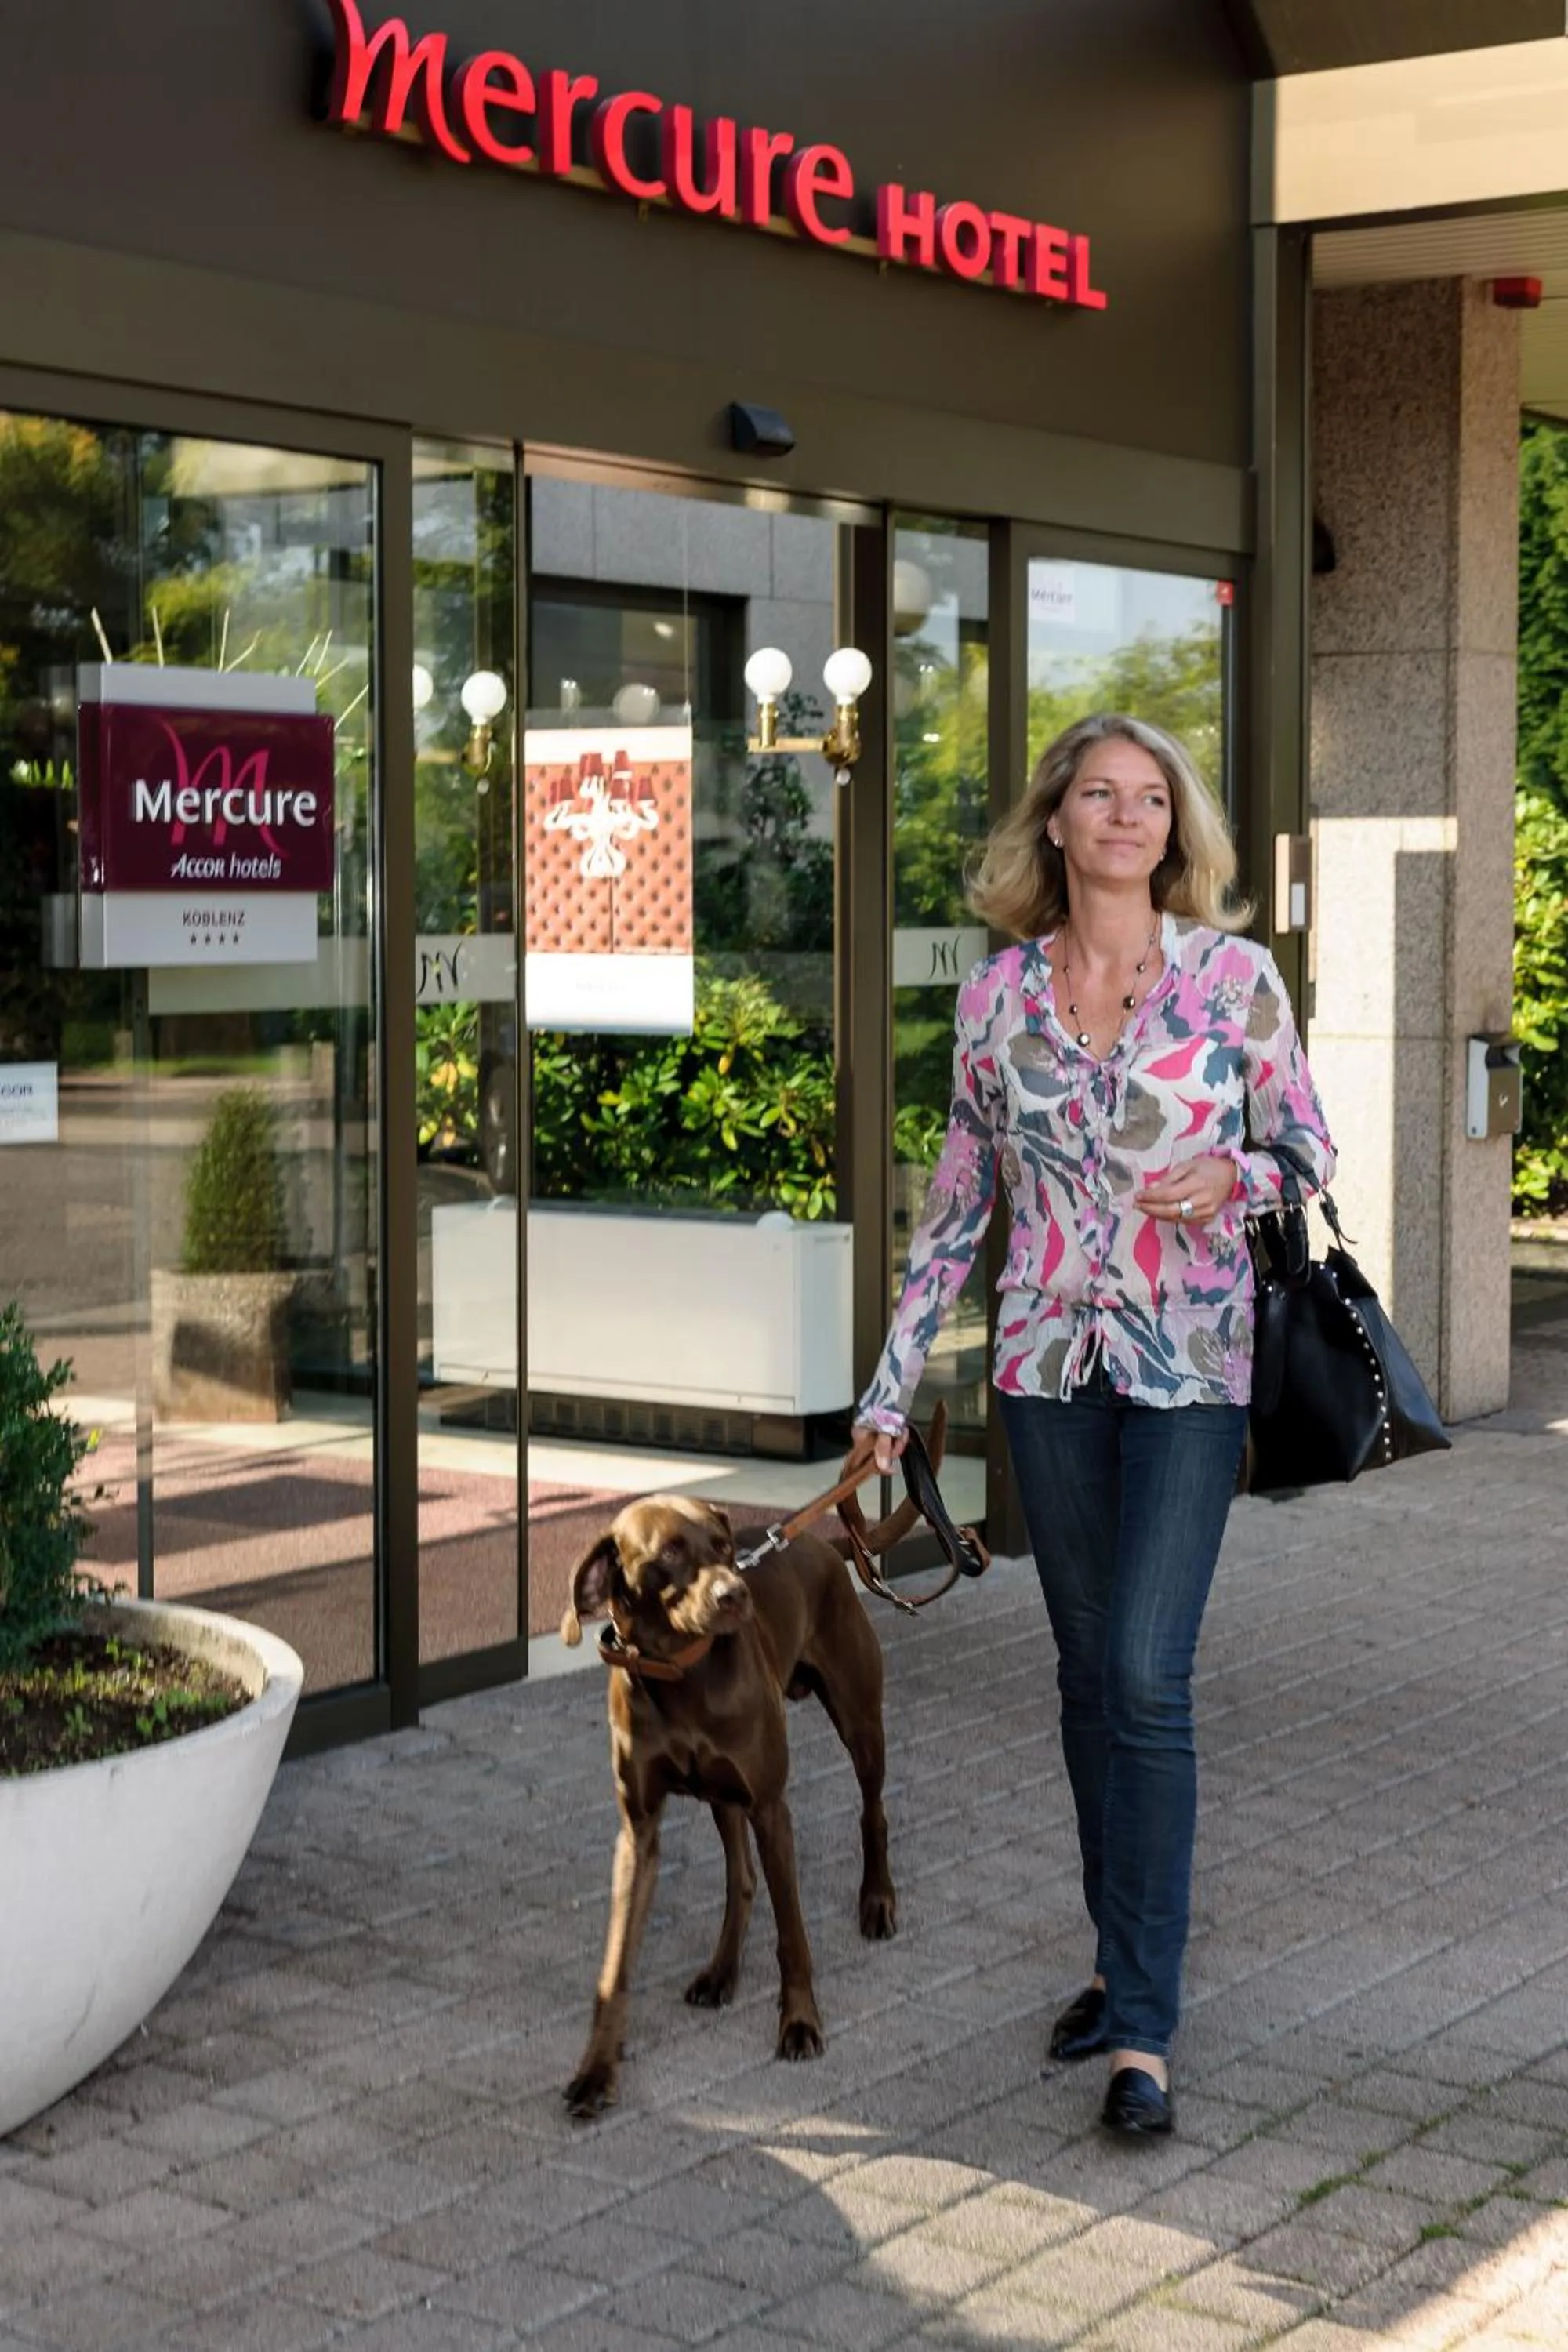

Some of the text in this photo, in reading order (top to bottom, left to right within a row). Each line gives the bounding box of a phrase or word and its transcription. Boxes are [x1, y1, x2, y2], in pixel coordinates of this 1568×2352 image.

[329, 0, 1107, 310] Mercure HOTEL
[133, 779, 317, 827] Mercure
[229, 851, 281, 879] hotels
[183, 909, 245, 927] KOBLENZ
